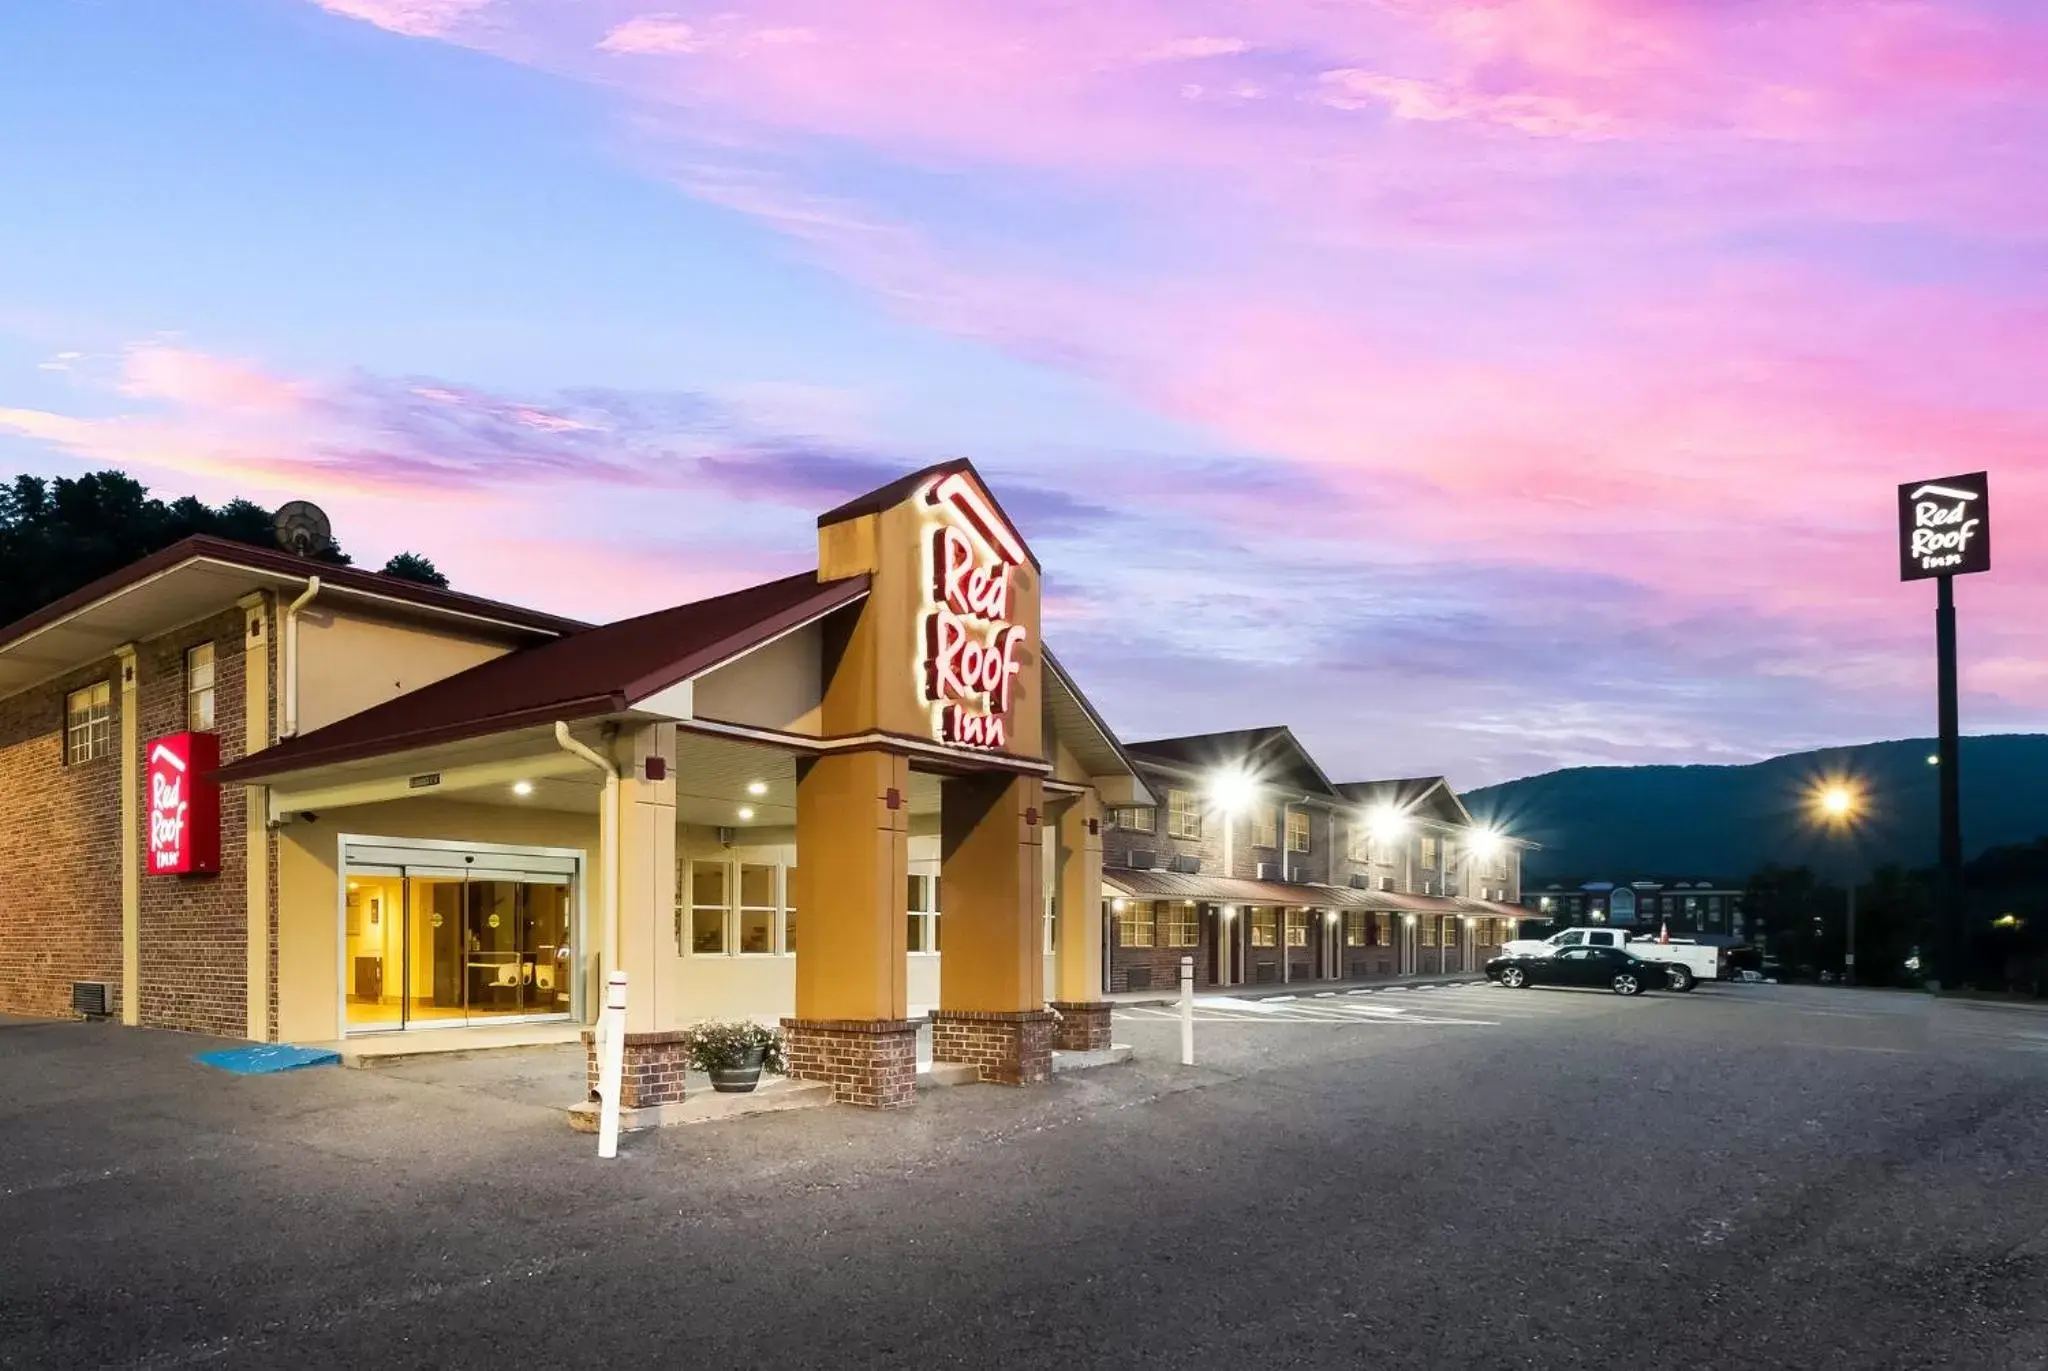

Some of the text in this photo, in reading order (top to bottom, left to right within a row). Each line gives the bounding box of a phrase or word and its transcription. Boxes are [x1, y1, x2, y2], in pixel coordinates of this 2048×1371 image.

[1915, 501, 1966, 528] Red
[1911, 518, 1980, 558] Roof
[942, 525, 1009, 621] Red
[935, 610, 1026, 713] Roof
[953, 703, 1005, 747] Inn
[152, 772, 181, 810] Red
[151, 801, 187, 852] Roof
